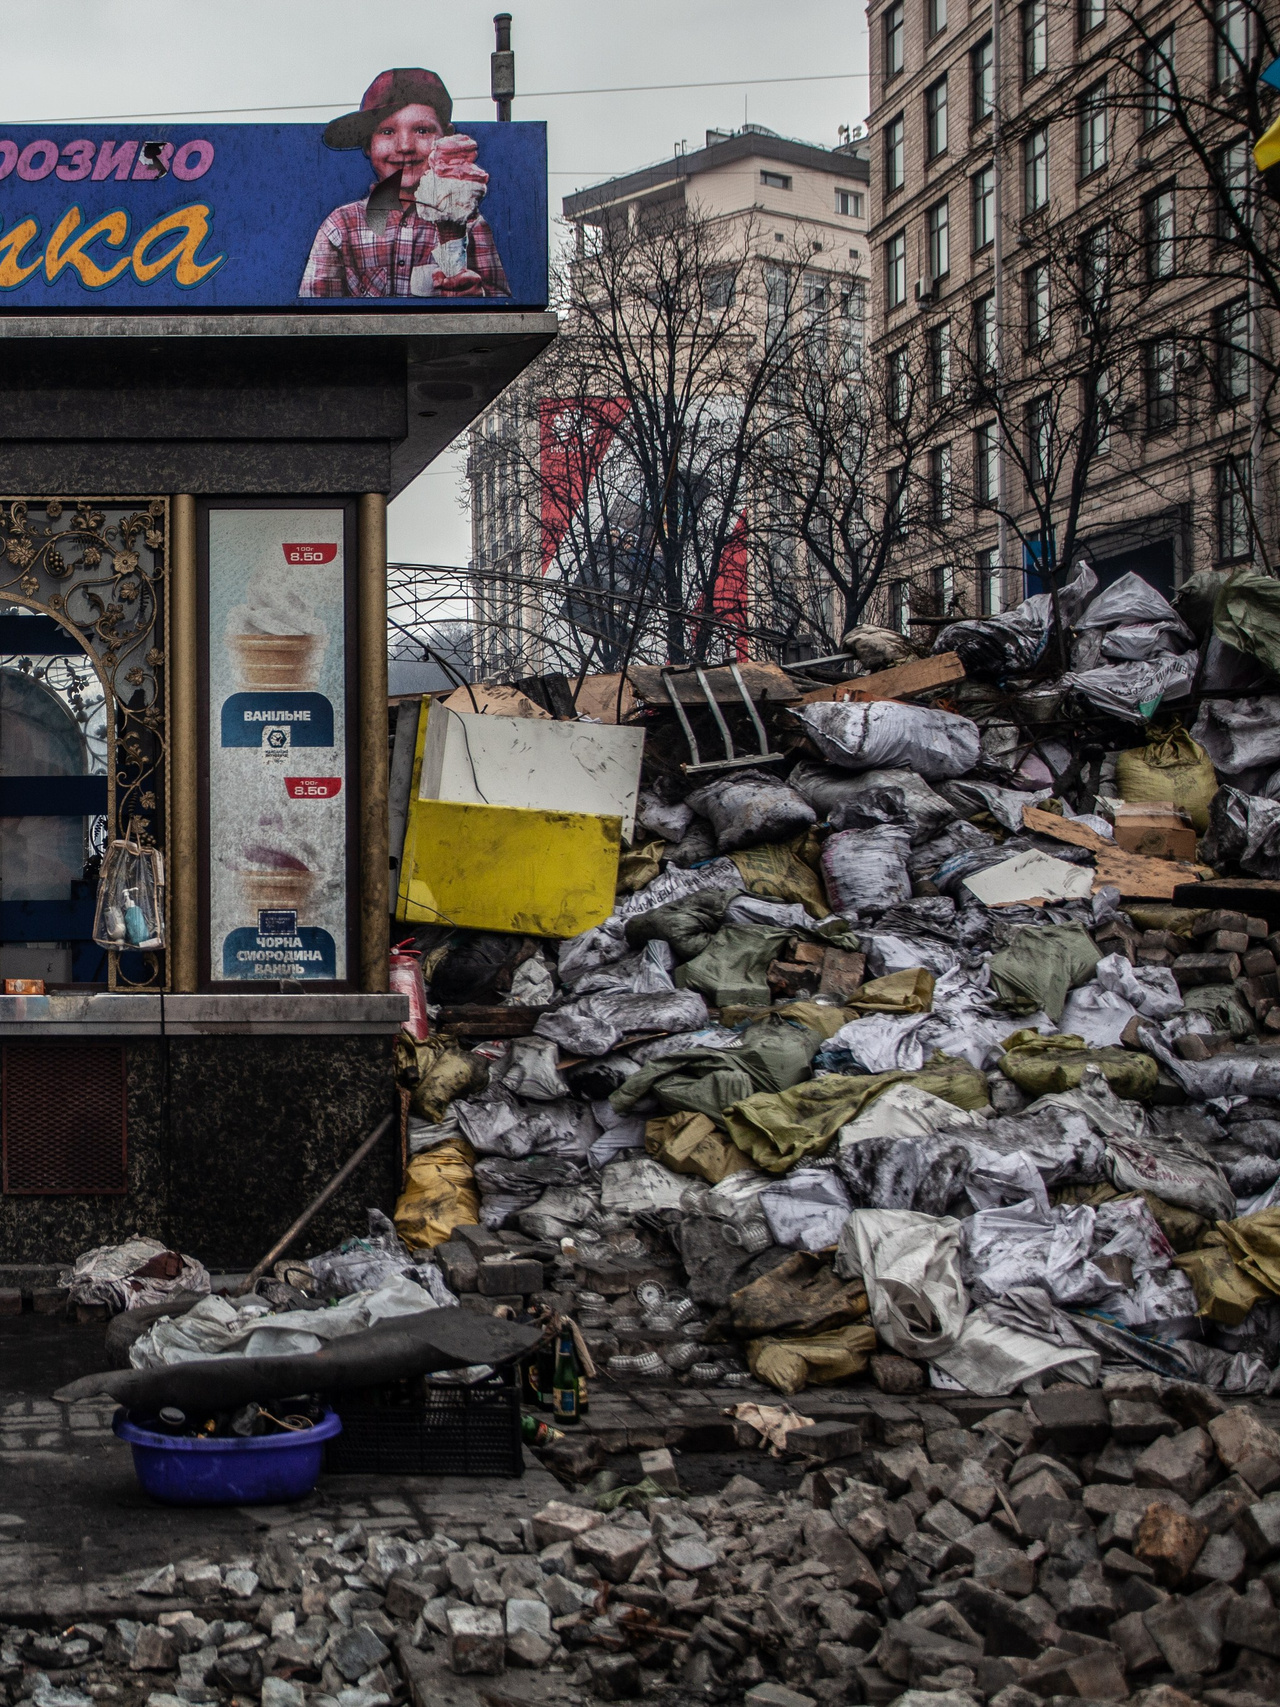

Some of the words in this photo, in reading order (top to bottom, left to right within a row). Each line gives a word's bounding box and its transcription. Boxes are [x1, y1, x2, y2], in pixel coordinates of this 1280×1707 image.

[290, 552, 323, 562] 8.50
[244, 710, 311, 722] ВАНІЛЬНЕ
[294, 786, 328, 796] 8.50
[256, 937, 303, 948] ЧОРНА
[236, 950, 323, 963] СМОРОДИНА
[254, 963, 305, 974] ВАНІЛЬ
